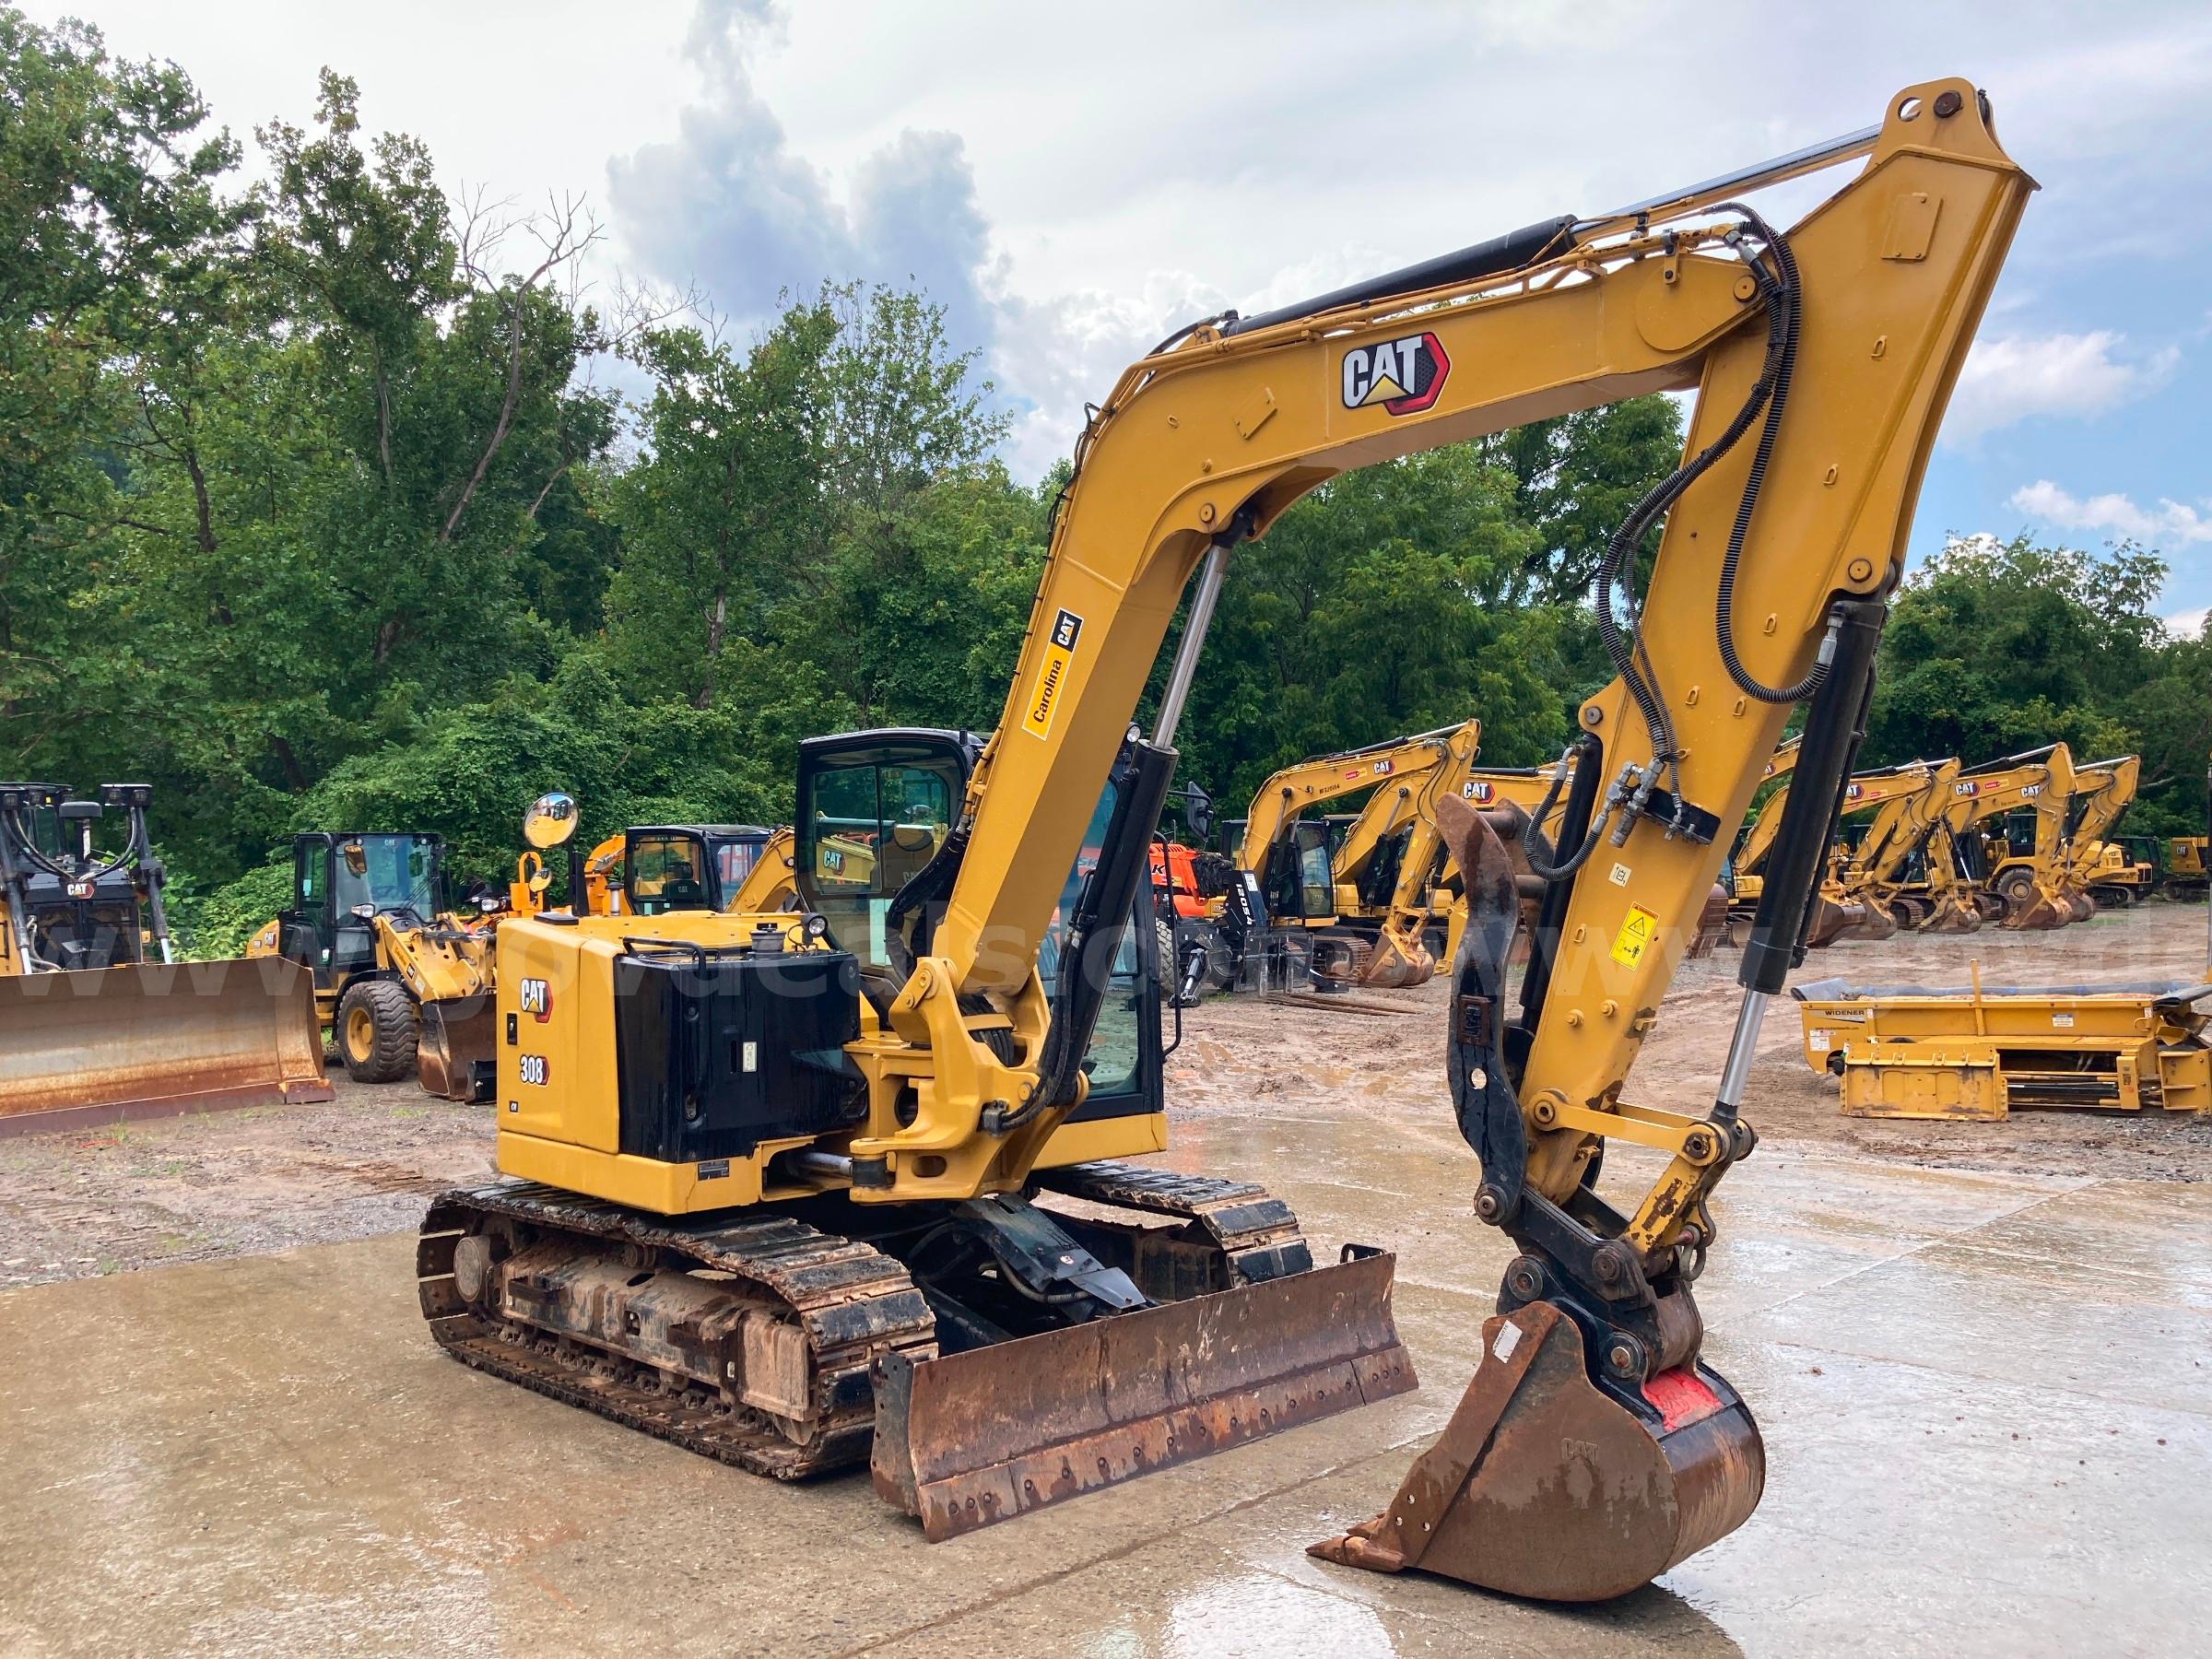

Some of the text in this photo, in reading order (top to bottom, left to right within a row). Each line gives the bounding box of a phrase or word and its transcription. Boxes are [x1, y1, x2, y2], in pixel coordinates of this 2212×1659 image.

[1343, 335, 1422, 407] CAT
[1032, 614, 1076, 724] Carolina CAT
[1373, 760, 1390, 774] CAT
[1463, 782, 1488, 800] CAT
[1846, 784, 1858, 797] AT
[1955, 782, 1974, 796] CAT
[2020, 784, 2040, 798] CAT
[823, 850, 841, 870] CAT
[67, 883, 88, 896] CAT
[521, 979, 546, 1013] CAT
[520, 1055, 544, 1085] 308
